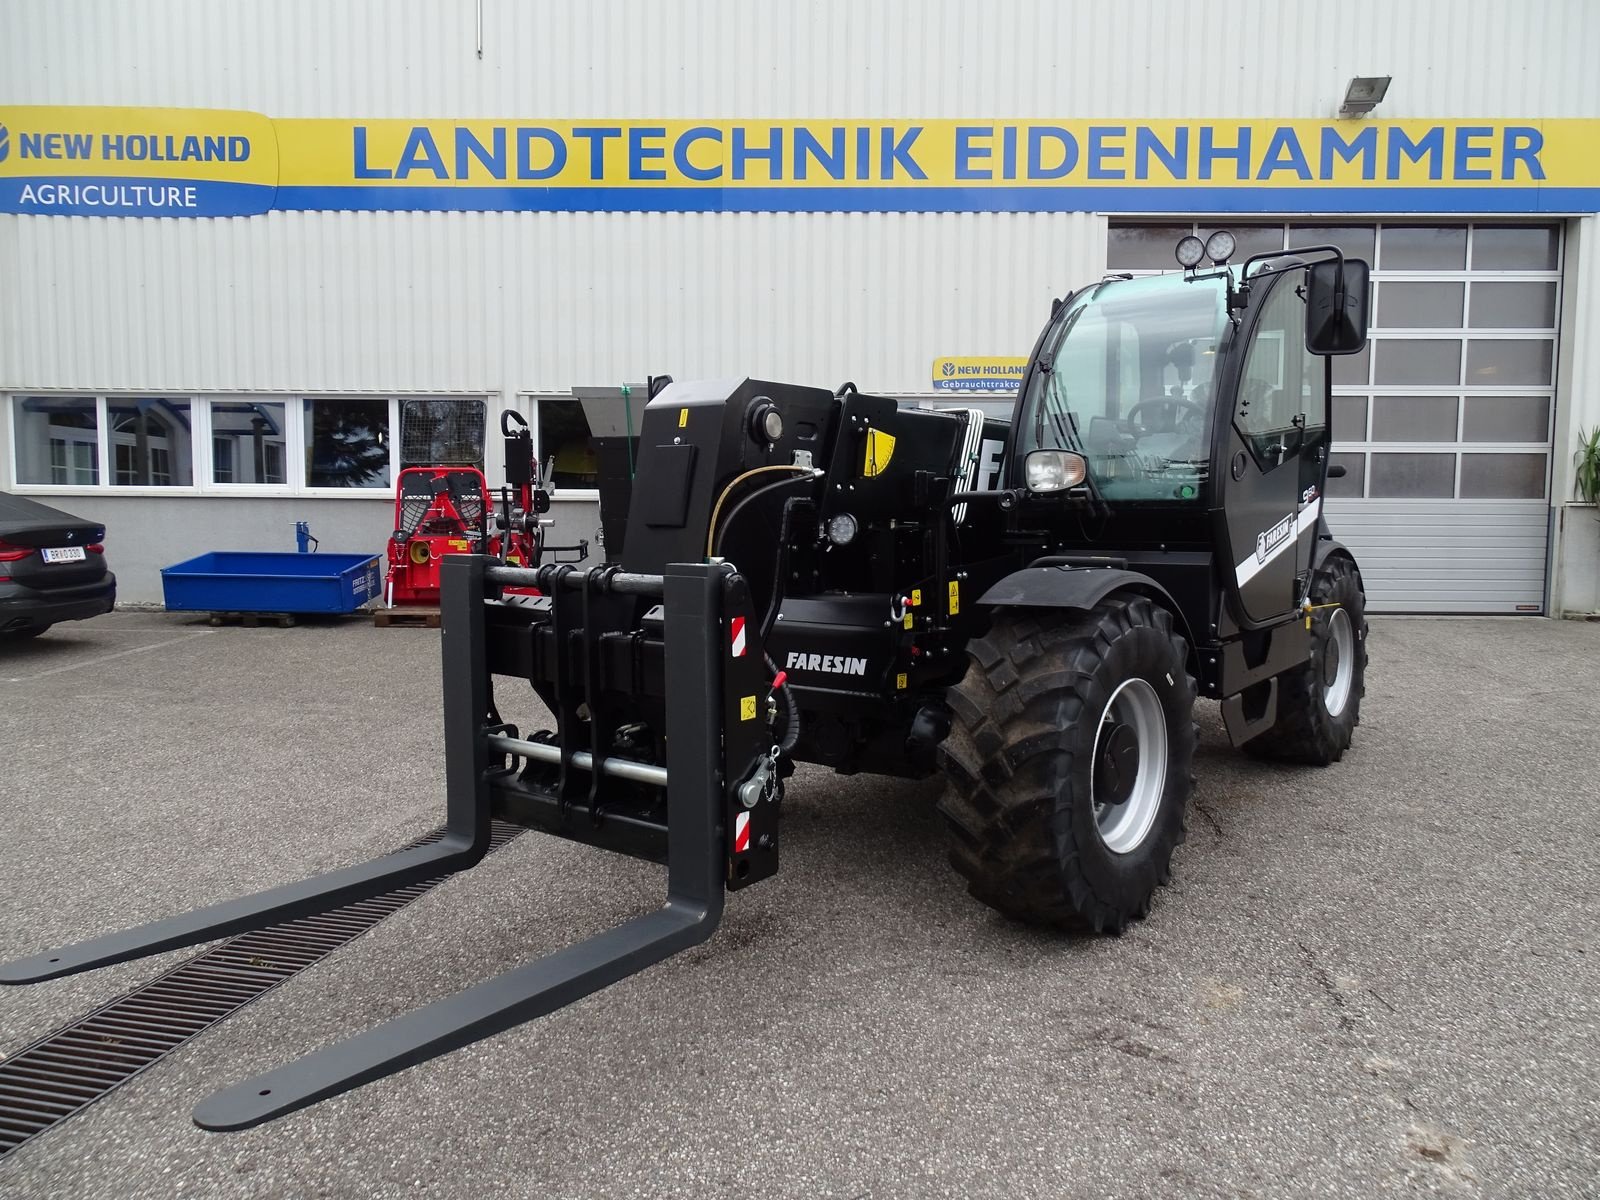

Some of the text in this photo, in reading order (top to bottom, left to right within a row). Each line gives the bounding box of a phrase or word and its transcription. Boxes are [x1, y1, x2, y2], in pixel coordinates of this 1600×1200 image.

[19, 133, 250, 162] NEW HOLLAND
[353, 126, 1546, 182] LANDTECHNIK EIDENHAMMER
[19, 184, 198, 208] AGRICULTURE
[958, 366, 981, 374] NEW
[1266, 520, 1290, 550] FARESIN
[786, 652, 867, 676] FARESIN
